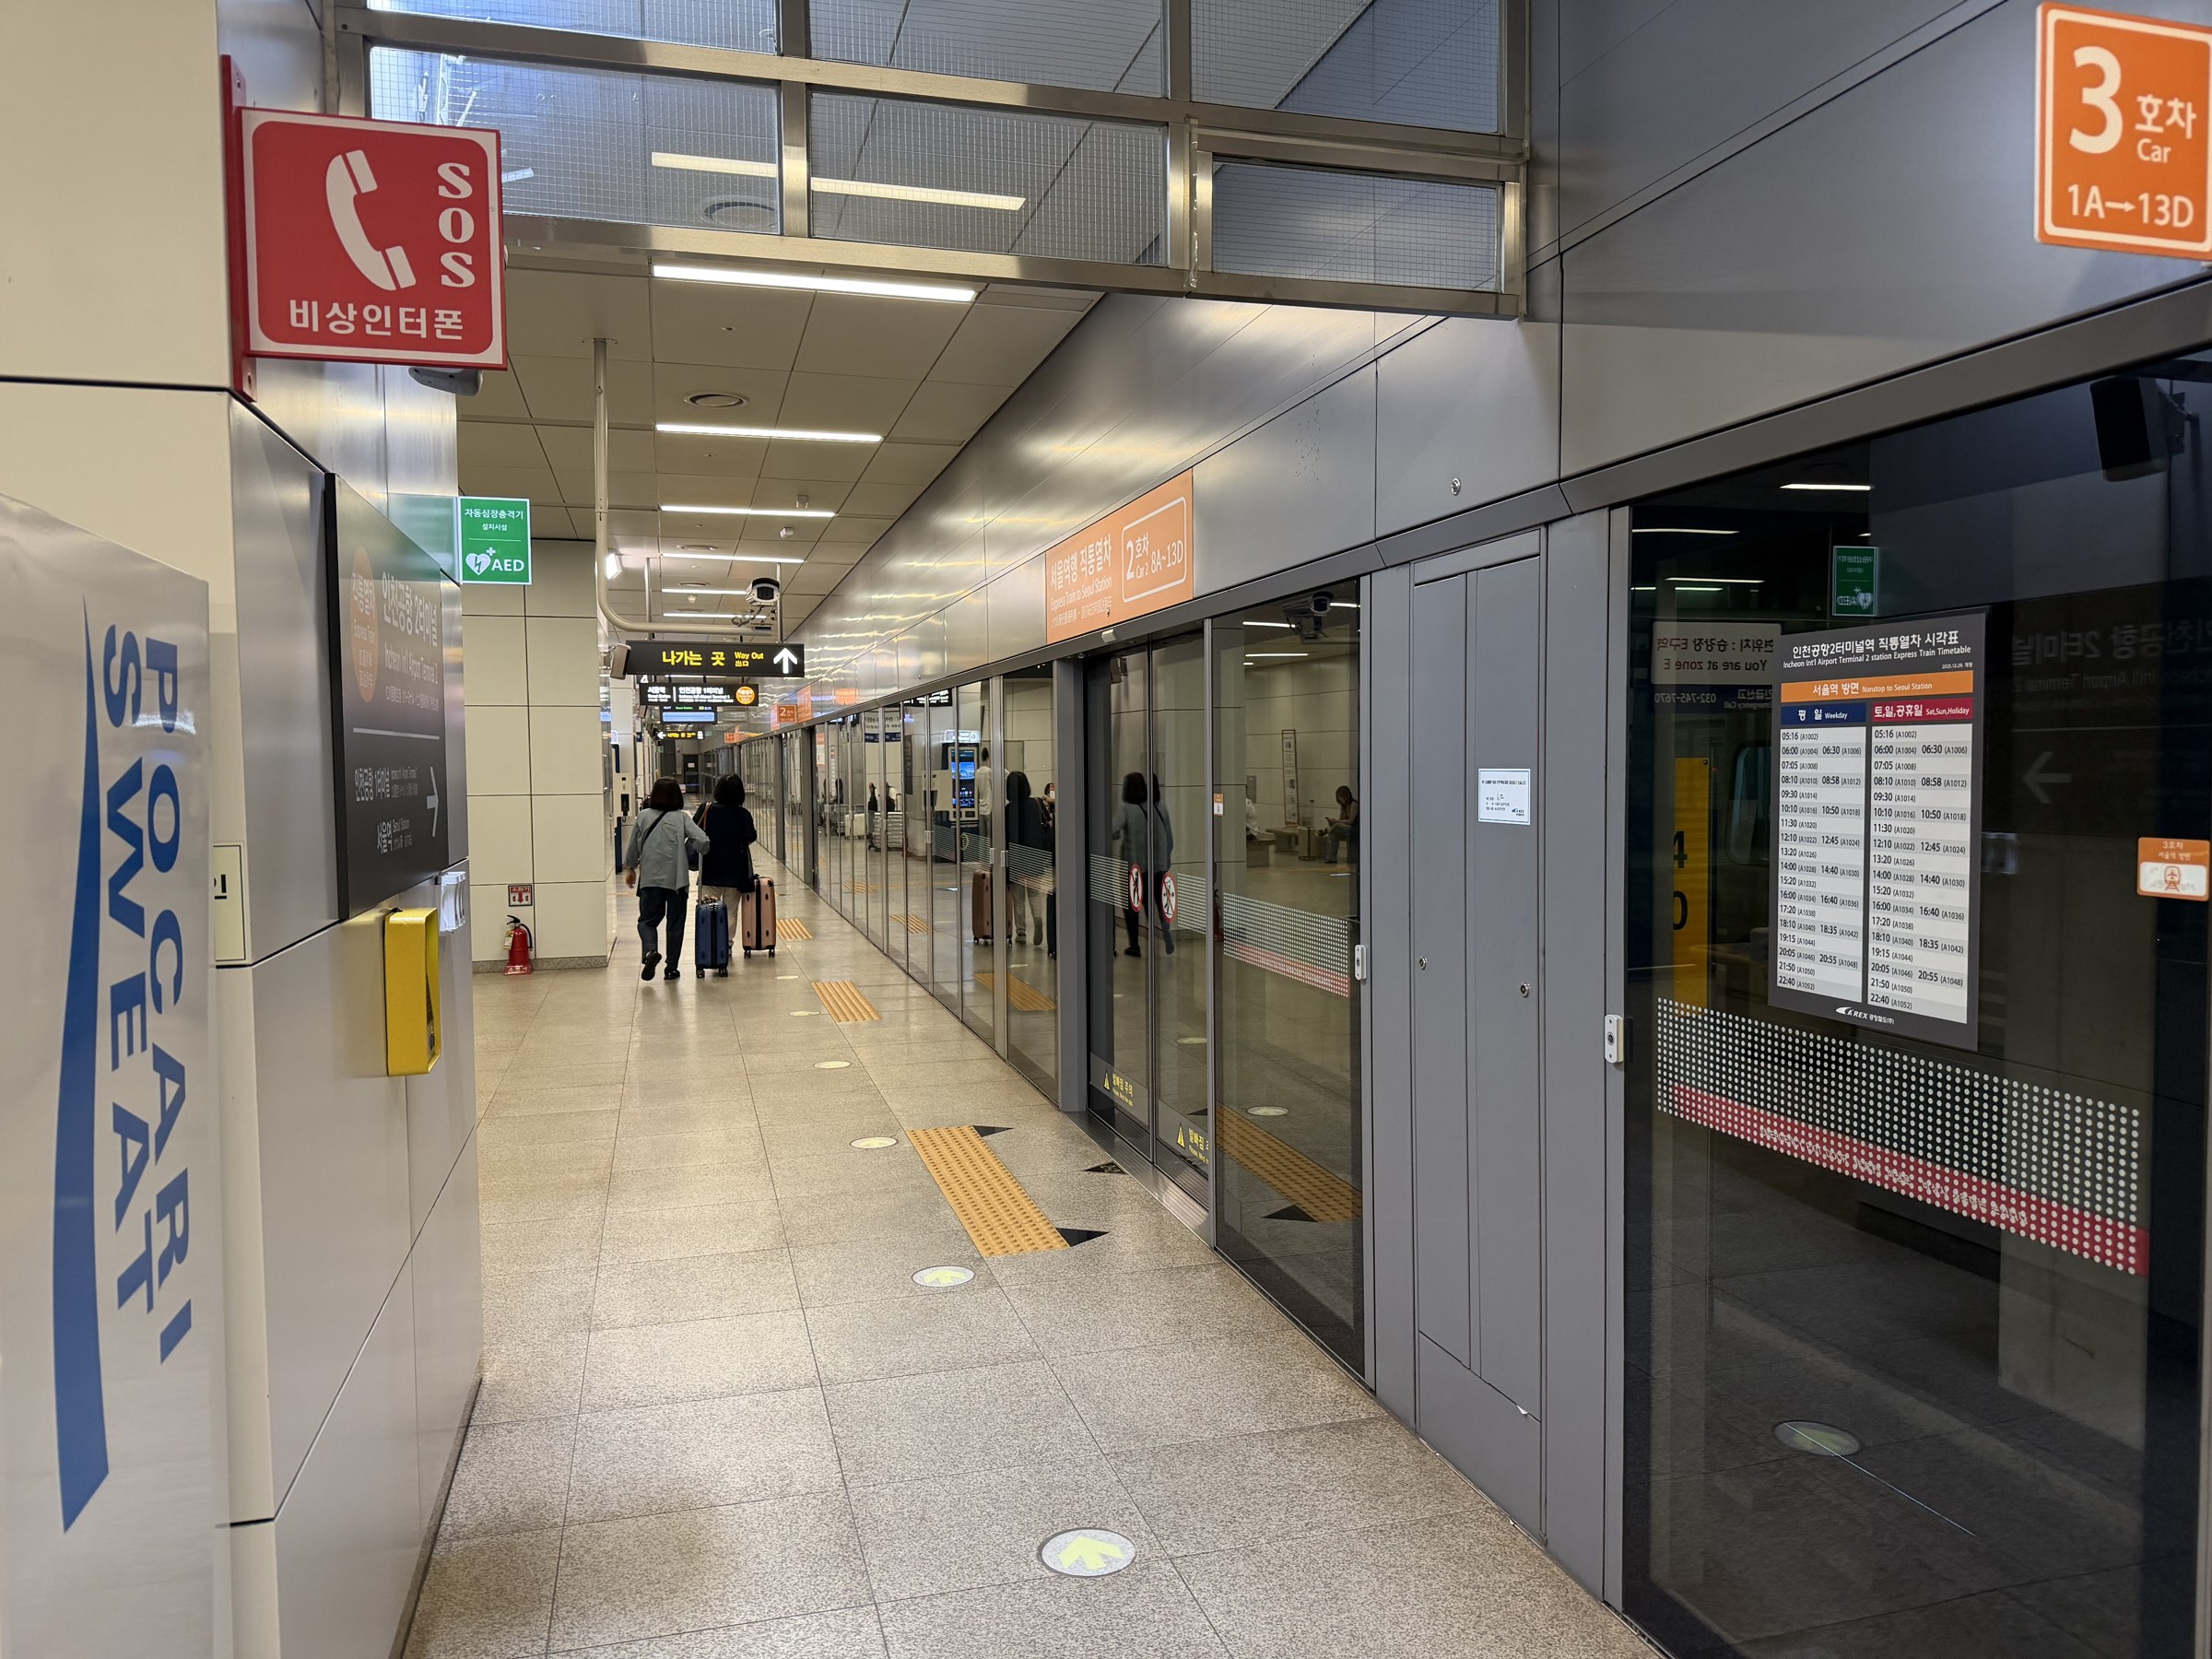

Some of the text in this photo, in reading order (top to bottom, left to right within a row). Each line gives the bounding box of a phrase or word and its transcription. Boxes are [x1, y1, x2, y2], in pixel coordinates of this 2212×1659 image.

[2069, 45, 2196, 154] 3 호차
[2136, 138, 2171, 163] Car
[437, 162, 476, 288] SOS
[289, 299, 464, 340] 비상인터폰
[464, 508, 524, 520] 자동심장충격기
[481, 523, 508, 531] 설치시설
[1050, 534, 1112, 591] 서울역행 직통열차
[1126, 532, 1149, 581] 2 호차
[491, 559, 524, 571] AED
[1135, 565, 1144, 579] Car
[351, 572, 376, 618] 직통열차
[1051, 595, 1065, 612] Express
[1065, 590, 1077, 606] Train
[1081, 580, 1094, 598] Seoul
[1094, 575, 1112, 594] Station
[382, 571, 438, 648] 인천공항 2터미널
[1793, 630, 1959, 659] 인천공항2터미널역 직통열차 시각표
[384, 641, 401, 672] Incheon
[662, 650, 725, 665] 나가는 곳
[735, 652, 764, 661] Way Out
[1783, 660, 1805, 668] Incheon
[1818, 657, 1838, 666] Airport
[1839, 655, 1865, 664] Terminal
[1871, 653, 1892, 661] station
[1893, 651, 1917, 660] Express
[1937, 645, 1971, 655] Timetable
[1813, 682, 1859, 697] 서울역 방면
[1912, 682, 1933, 690] Station
[780, 707, 786, 716] 2
[1825, 711, 1848, 720] Weekday
[1875, 730, 1893, 738] 05:16
[1875, 746, 1893, 754] 06:00
[1896, 747, 1916, 755] (A1004)
[1922, 745, 1942, 753] 06:30
[1875, 761, 1893, 770] 07:05
[1874, 777, 1892, 785] 08:10
[1922, 777, 1942, 786] 08:58
[1944, 780, 1967, 788] (A1012)
[1874, 793, 1915, 803] 09:30 (A1014)
[1874, 808, 1892, 817] 10:10
[1922, 810, 1941, 818] 10:50
[1944, 812, 1966, 821] (A1018)
[1874, 824, 1892, 832] 11:30
[1874, 839, 1965, 854] 12:10 (A1022) 12:45 (A1024)
[1873, 854, 1914, 866] 13:20 (A1026)
[1873, 870, 1965, 888] 14:00 (A1028) 14:40 (A1030)
[1873, 886, 1914, 899] 15:20 (A1032)
[1872, 901, 1964, 921] 16:00 (A1034) 16:40 (A1036)
[1872, 916, 1913, 930] 17:20 (A1038)
[1872, 932, 1963, 954] 18:10 (A1040) 18:35 (A1042)
[1872, 947, 1912, 961] 19:15 (A1044)
[104, 623, 159, 1313] SWEAT
[1871, 962, 1962, 987] 20:05 (A1046) 20:55 (A1048)
[1871, 978, 1912, 994] 21:50 (A1050)
[145, 635, 192, 1365] POCARI
[1871, 994, 1912, 1009] 22:40 (A1052)
